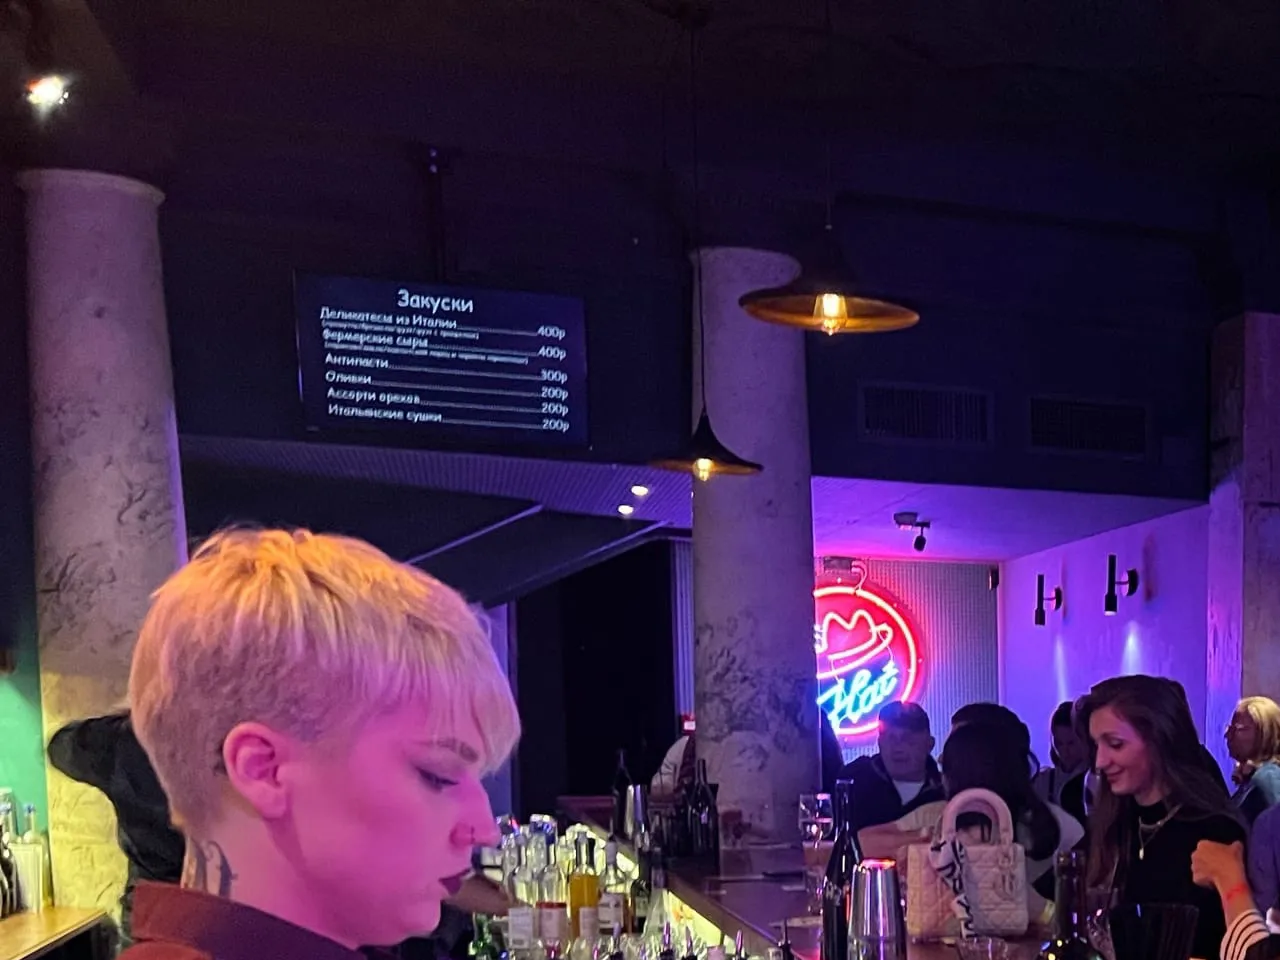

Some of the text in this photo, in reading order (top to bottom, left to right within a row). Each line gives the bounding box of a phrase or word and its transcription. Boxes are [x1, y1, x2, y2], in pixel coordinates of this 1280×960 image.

[398, 289, 474, 314] Закуски
[320, 305, 393, 324] Деликатесы
[396, 315, 410, 326] из
[413, 314, 458, 329] Италии
[537, 325, 566, 341] 400р
[322, 328, 394, 345] Фермерские
[538, 345, 567, 362] 400р
[325, 352, 568, 385] Антипасти 300р
[325, 370, 569, 401] Оливки 200р
[327, 387, 569, 417] Ассорти орехов 200р
[328, 403, 404, 420] Итальянские
[542, 418, 570, 433] 200р
